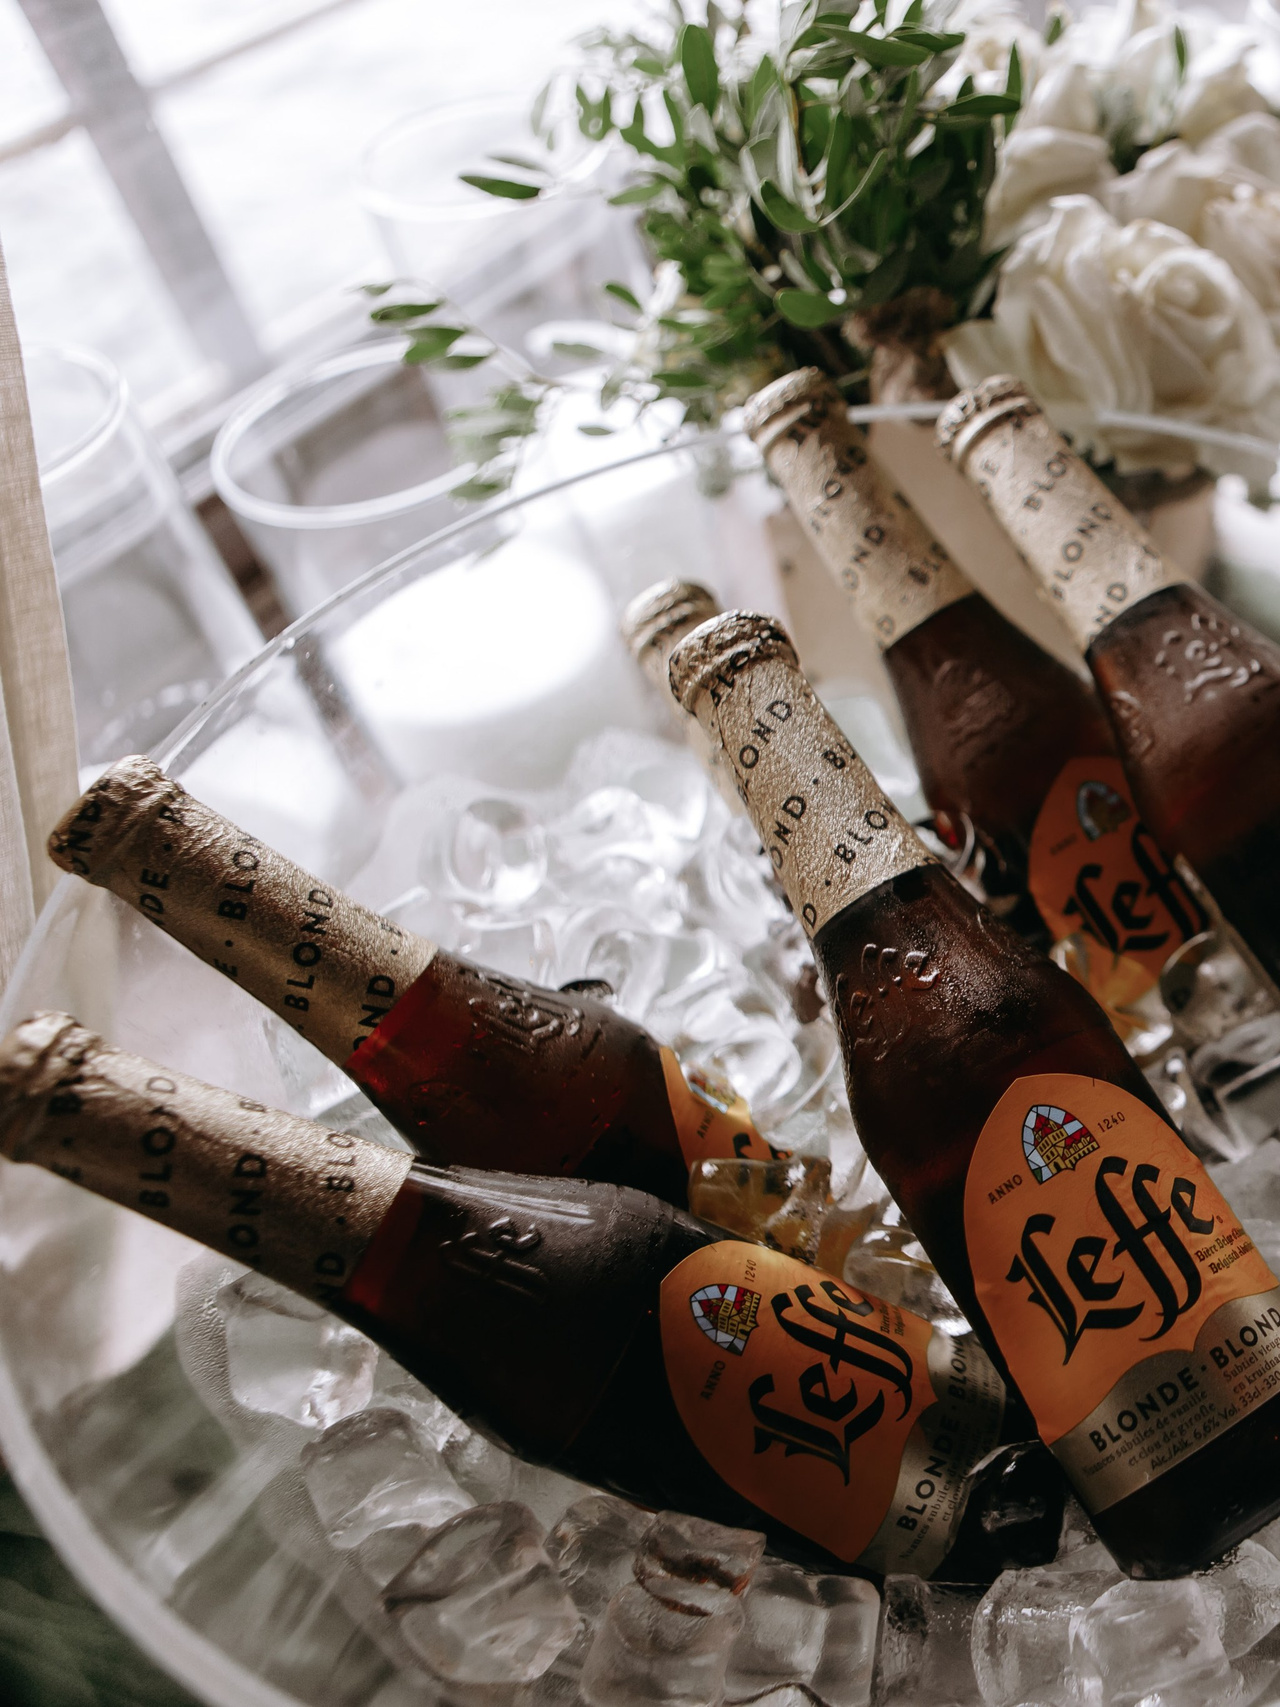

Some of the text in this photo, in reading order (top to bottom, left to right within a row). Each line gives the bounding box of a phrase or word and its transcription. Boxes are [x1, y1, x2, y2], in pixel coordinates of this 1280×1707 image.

[284, 887, 335, 1013] BLOND
[986, 1110, 1127, 1206] ANNO 1240
[1005, 1155, 1215, 1366] Leffe
[701, 1258, 758, 1400] ANNO 1240
[1223, 1353, 1259, 1383] Subtiel
[747, 1279, 914, 1487] Leffe
[1088, 1366, 1200, 1453] BLONDE
[1156, 1412, 1171, 1430] de
[1193, 1415, 1221, 1441] 6,6%
[1217, 1405, 1241, 1421] Vol.
[1232, 1380, 1246, 1395] en
[896, 1412, 961, 1533] BLONDE
[1162, 1428, 1177, 1444] de
